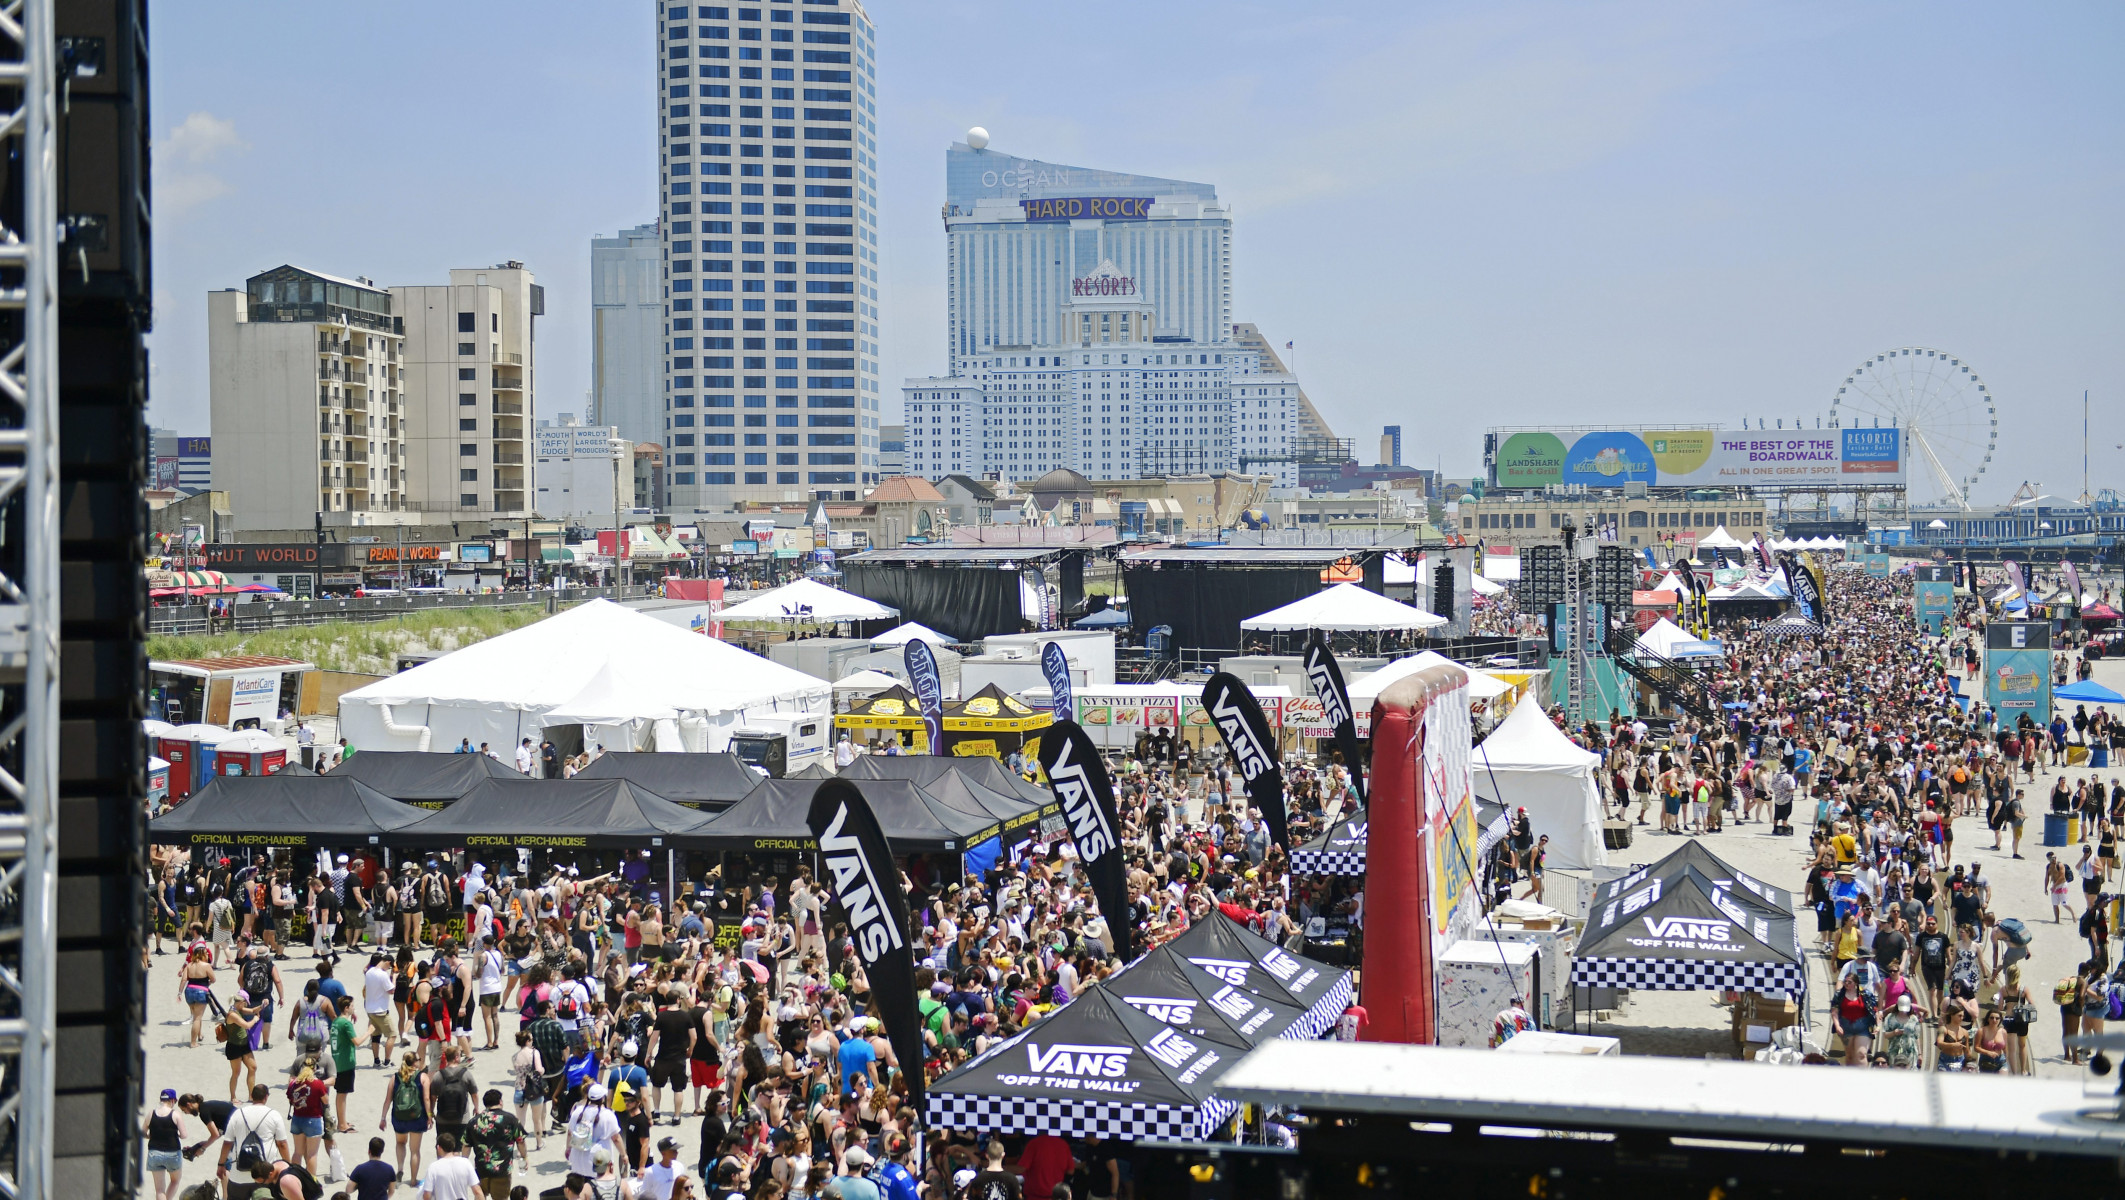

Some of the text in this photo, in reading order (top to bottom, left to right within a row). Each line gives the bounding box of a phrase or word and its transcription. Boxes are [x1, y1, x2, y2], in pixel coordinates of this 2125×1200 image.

[1026, 199, 1147, 218] HARD ROCK
[1075, 277, 1136, 296] RESORTS
[1847, 433, 1893, 444] RESORTS
[1721, 440, 1834, 451] THE BEST OF THE
[1749, 451, 1838, 461] BOARDWALK.
[1506, 459, 1560, 467] LANDSHARK
[256, 548, 317, 562] WORLD
[409, 546, 441, 559] WORLD
[1874, 545, 1881, 554] G
[1932, 568, 1941, 581] F
[1794, 568, 1818, 602] VANS
[2011, 626, 2026, 648] E
[236, 678, 275, 691] AtlantiCare
[1307, 646, 1349, 730] VANS
[1083, 698, 1173, 706] NY STYLE PIZZA
[1293, 712, 1321, 725] Fries
[1212, 685, 1274, 781] VANS
[1048, 737, 1117, 863] VANS
[191, 834, 307, 845] OFFICIAL MERCHANDISE
[466, 836, 587, 847] OFFICIAL MERCHANDISE
[754, 839, 801, 849] OFFICIAL
[820, 800, 903, 964] VANS
[1643, 917, 1732, 942] VANS
[1665, 940, 1696, 949] THE
[1258, 946, 1302, 981] VANS
[1207, 984, 1255, 1021] VANS
[1143, 1027, 1199, 1069] VANS
[1026, 1043, 1134, 1078] VANS
[1044, 1077, 1075, 1090] THE
